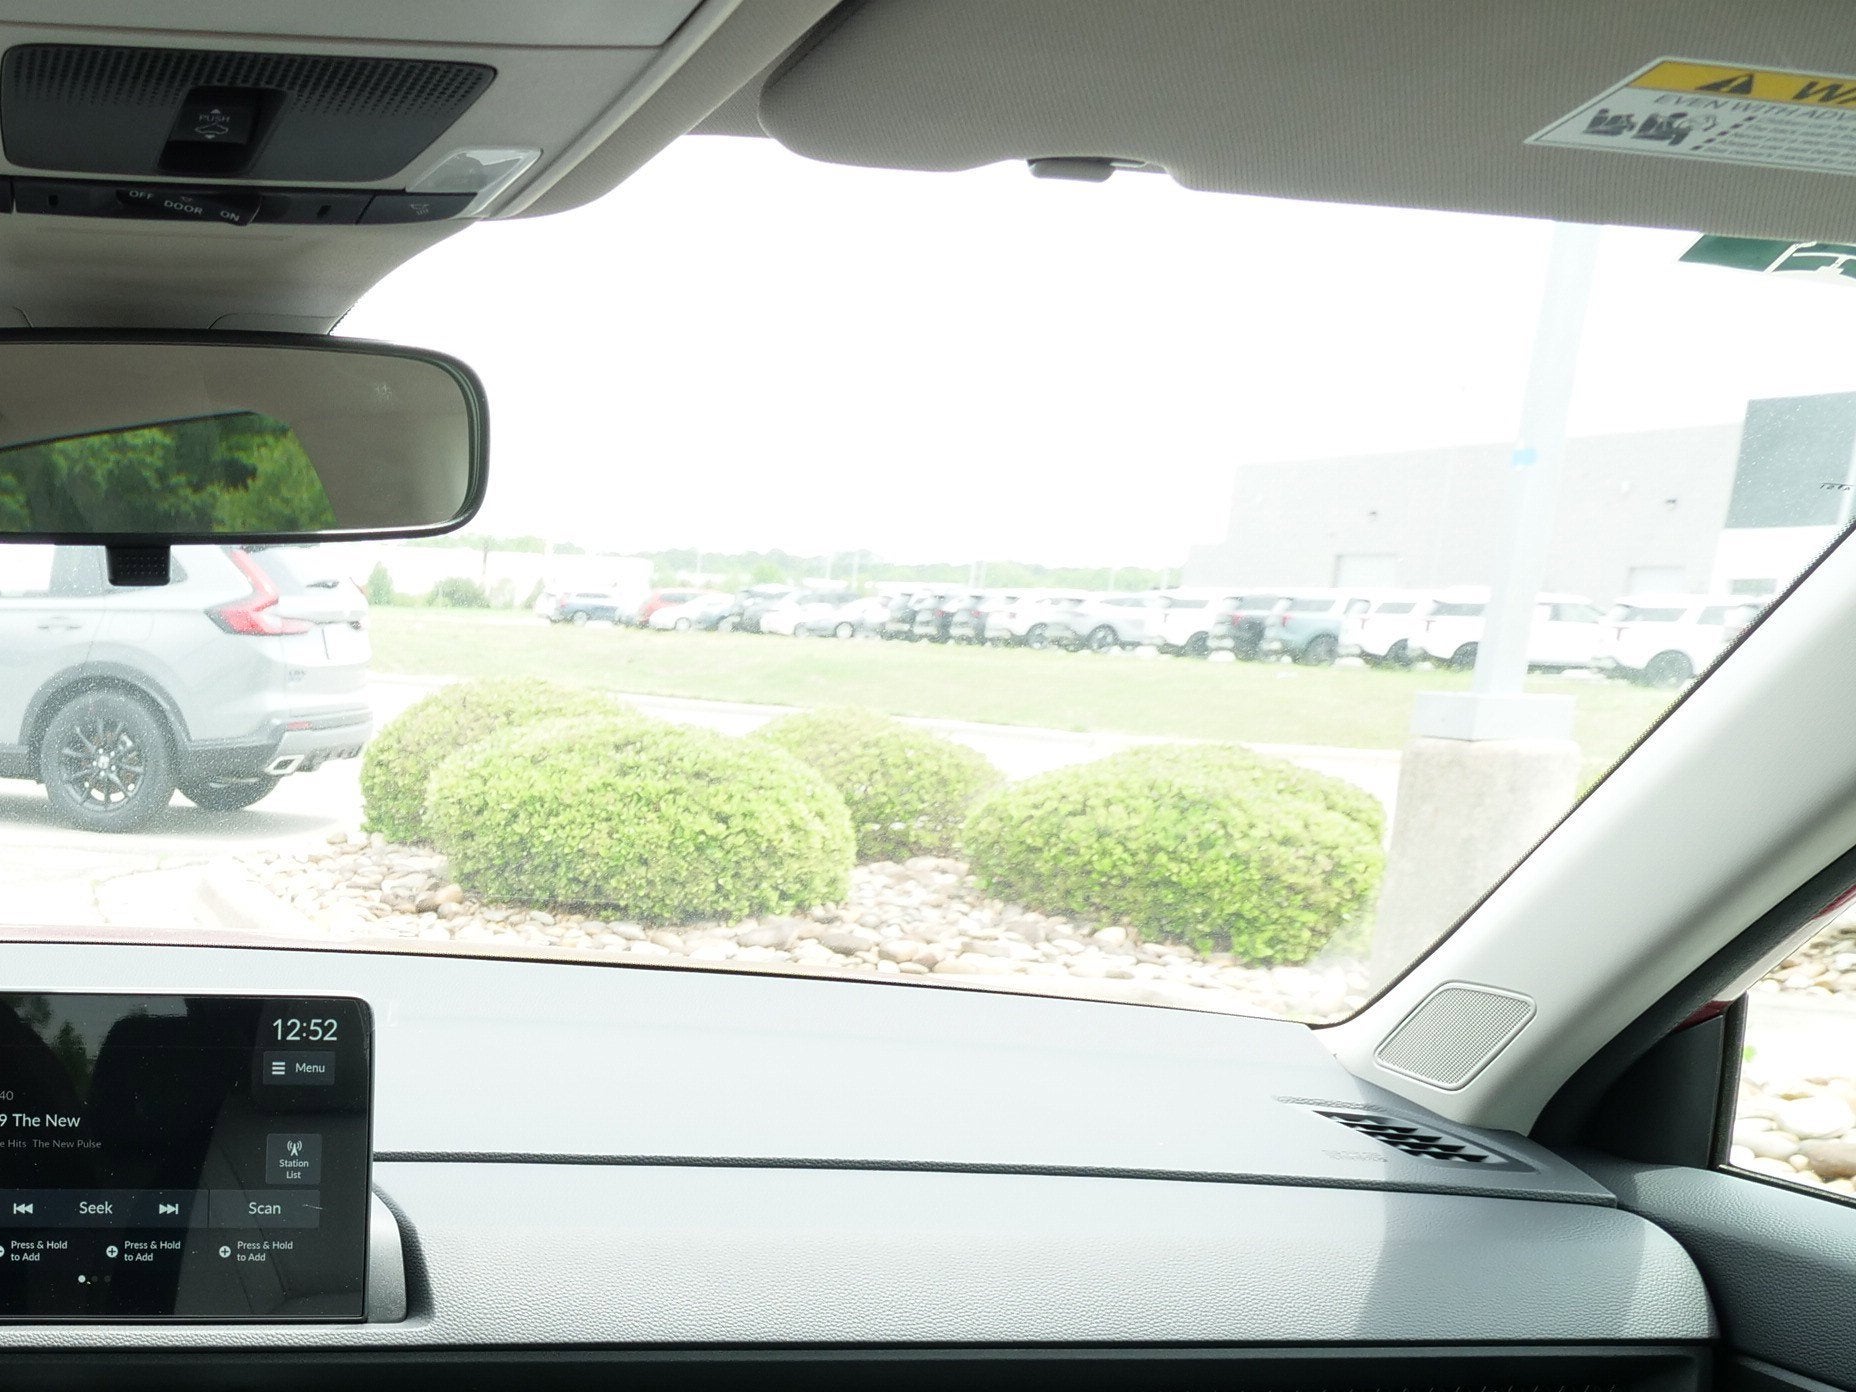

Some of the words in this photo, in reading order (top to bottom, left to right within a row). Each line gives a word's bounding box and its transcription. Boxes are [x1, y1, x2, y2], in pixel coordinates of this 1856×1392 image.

[129, 190, 154, 200] OFF
[164, 200, 203, 215] DOOR
[220, 210, 240, 221] ON
[273, 1019, 338, 1041] 12:52
[296, 1062, 325, 1072] Menu
[0, 1091, 14, 1100] 40
[12, 1114, 41, 1127] The
[45, 1114, 80, 1127] New
[8, 1139, 26, 1148] Hits
[33, 1139, 50, 1148] The
[53, 1139, 74, 1148] New
[77, 1139, 102, 1148] Pulse
[279, 1159, 309, 1167] Station
[286, 1171, 301, 1179] List
[79, 1201, 113, 1215] Seek
[249, 1201, 281, 1215] Scan
[11, 1240, 35, 1250] Press
[48, 1240, 68, 1251] Hold
[11, 1253, 21, 1262] to
[24, 1252, 40, 1262] Add
